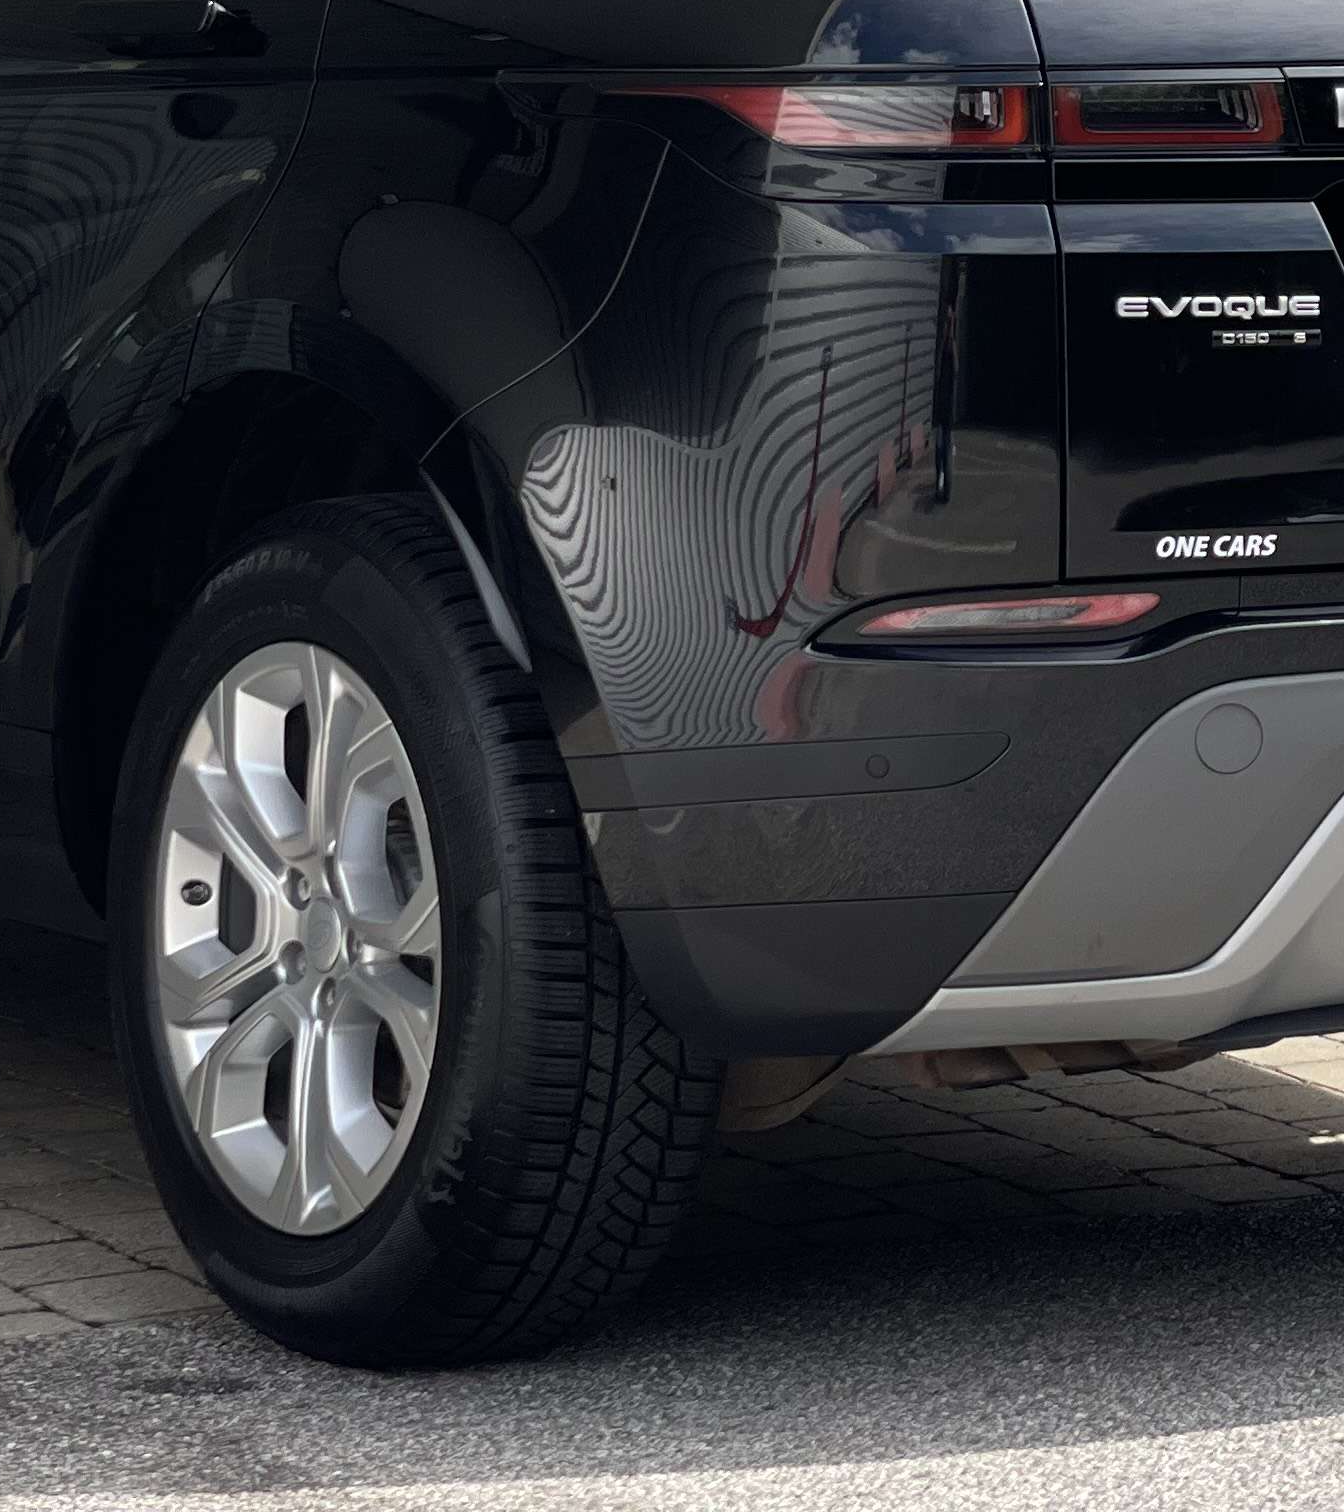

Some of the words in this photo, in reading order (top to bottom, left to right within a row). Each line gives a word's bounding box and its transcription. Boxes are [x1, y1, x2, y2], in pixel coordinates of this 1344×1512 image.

[1115, 294, 1321, 320] EVOQUE
[1221, 332, 1270, 345] D150
[1156, 535, 1211, 558] ONE
[1213, 534, 1278, 557] CARS
